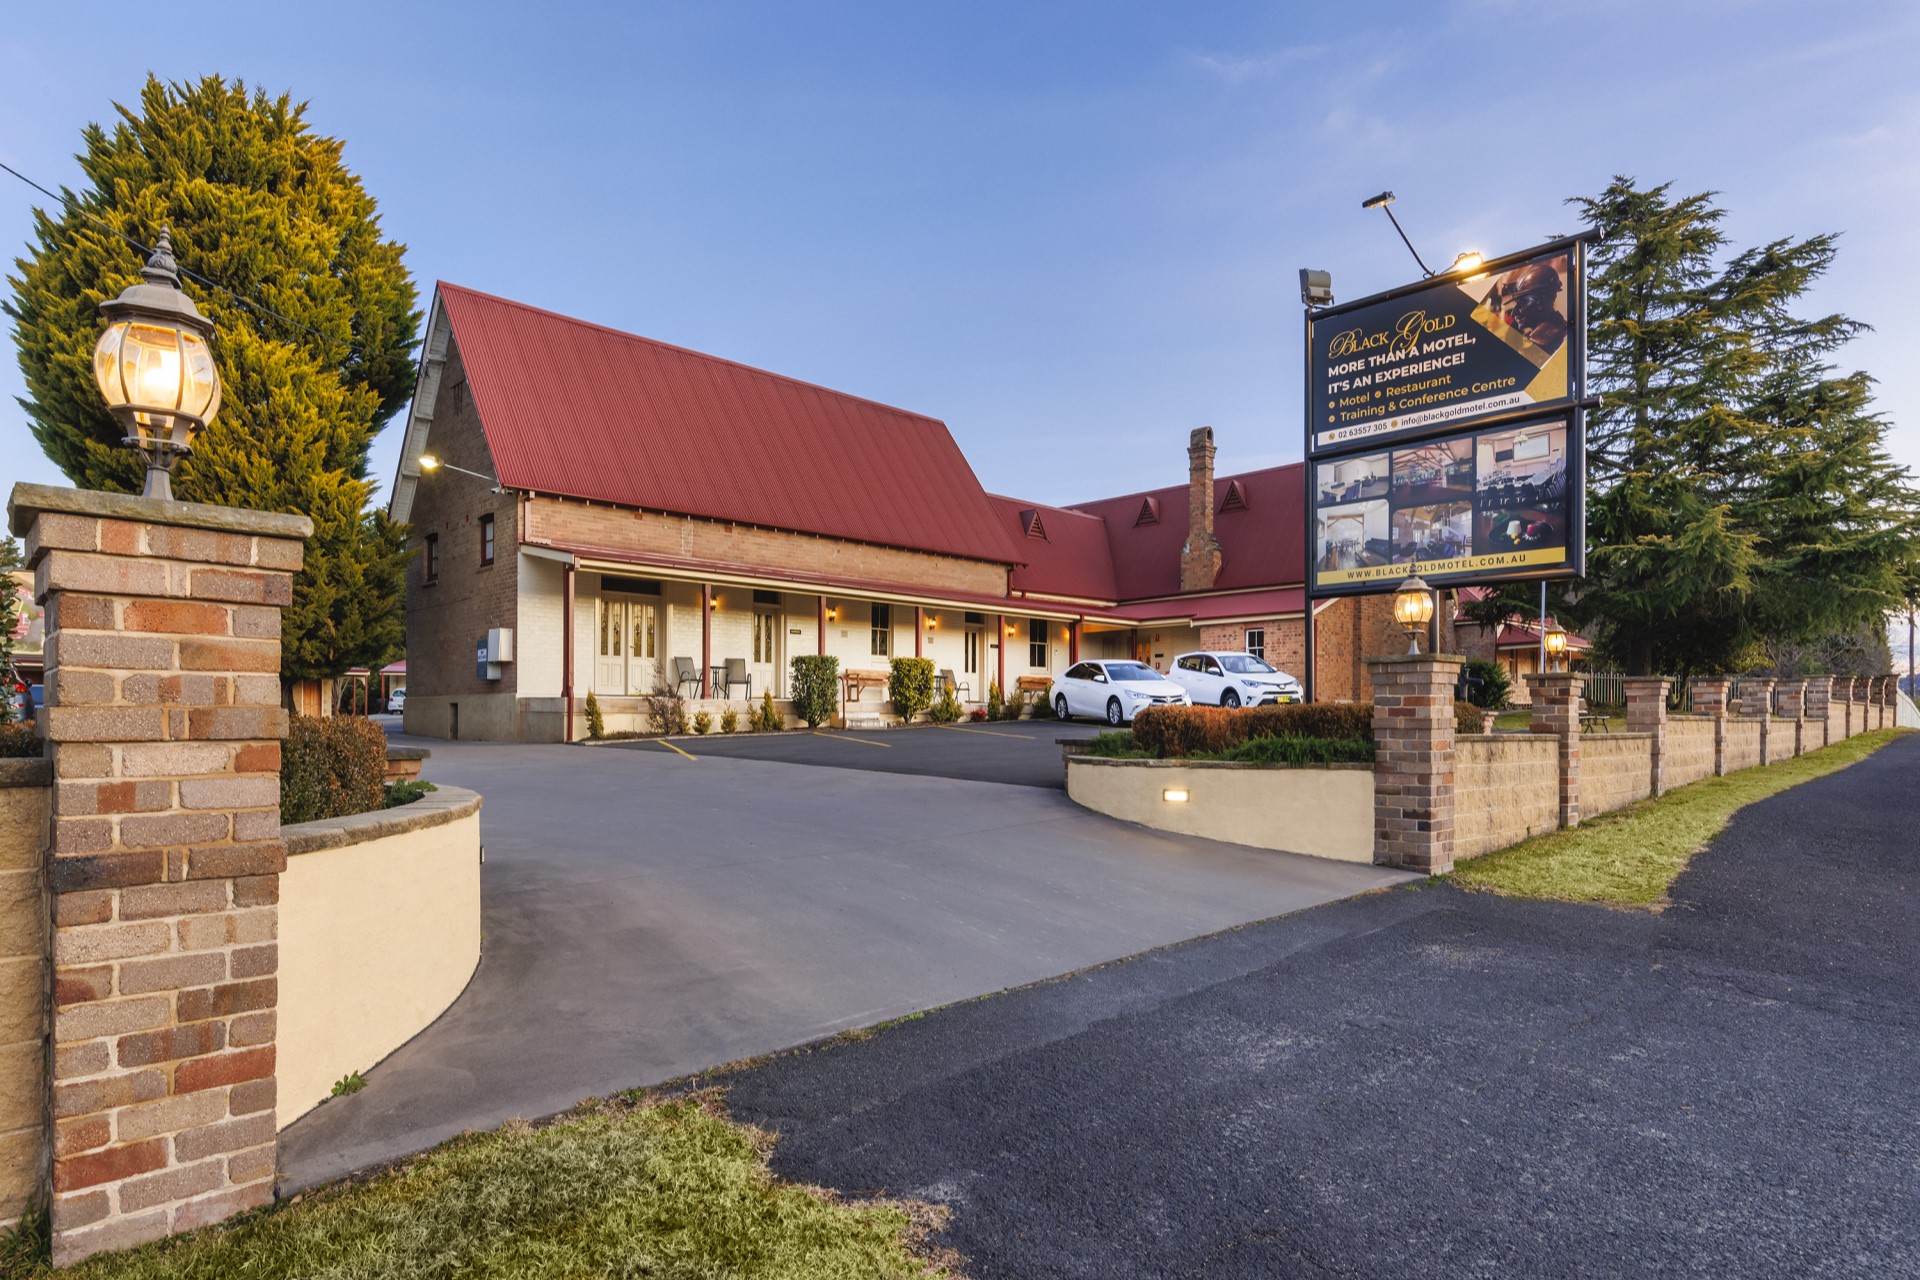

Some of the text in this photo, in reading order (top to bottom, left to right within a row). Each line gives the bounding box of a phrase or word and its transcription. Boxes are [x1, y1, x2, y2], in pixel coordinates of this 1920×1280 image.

[1328, 310, 1456, 359] BLACK GOLD
[1328, 332, 1476, 378] MORE THAN A MOTEL,
[1328, 352, 1465, 395] IT'S AN EXPERIENCE!
[1339, 374, 1452, 408] Motel Restaurant
[1338, 397, 1520, 439] 02 63557 305 info@blackgoldmotel.com.au
[1340, 376, 1516, 422] Training & Conference Centre
[1347, 554, 1527, 580] WWW.BLACKOLDMOTEL.COM.AU
